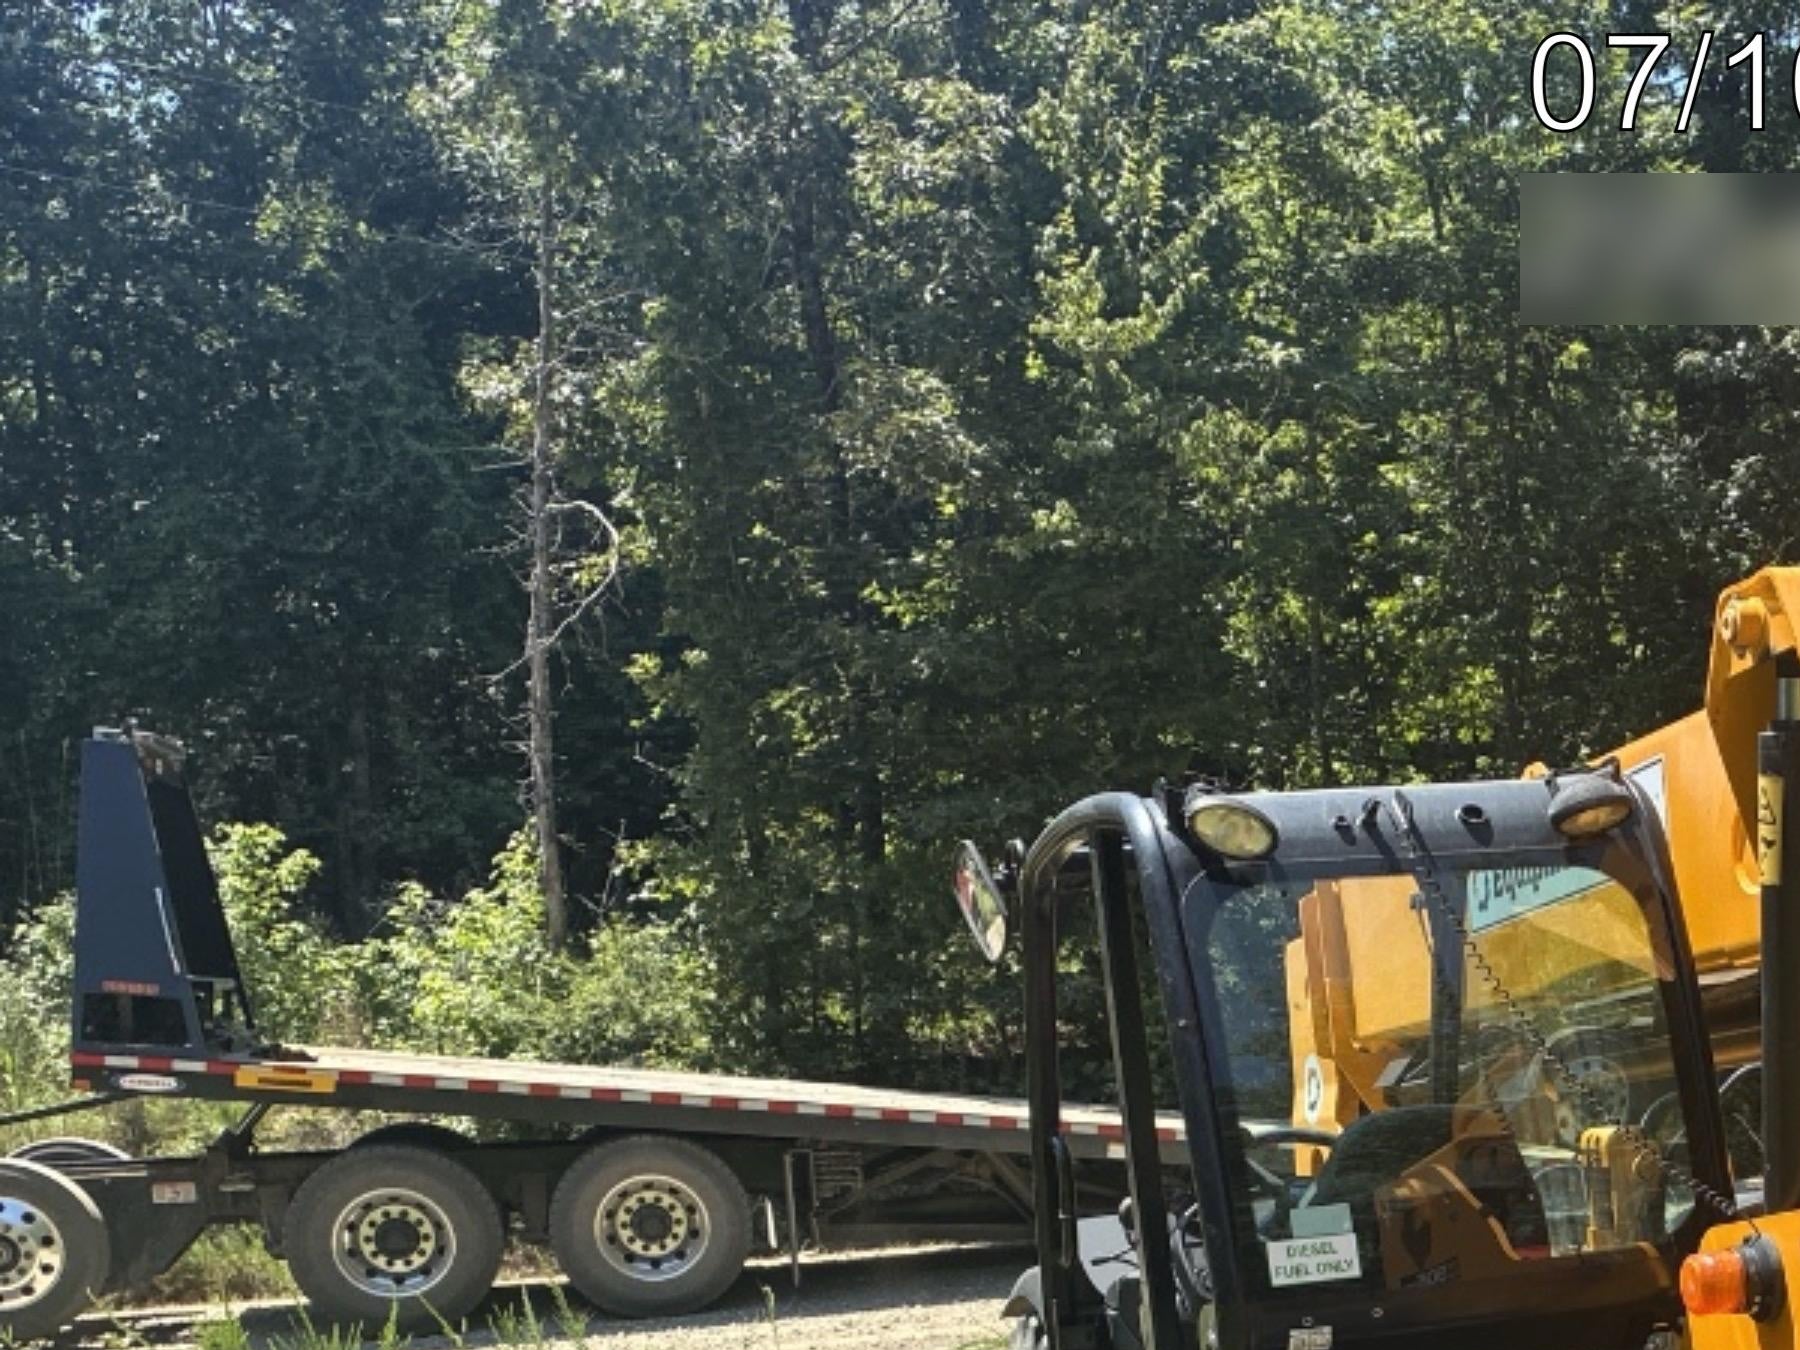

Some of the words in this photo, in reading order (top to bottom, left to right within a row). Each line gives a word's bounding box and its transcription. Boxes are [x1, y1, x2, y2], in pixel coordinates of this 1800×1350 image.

[1286, 1242, 1338, 1259] DIESEL
[1275, 1263, 1312, 1280] FUEL
[1315, 1257, 1354, 1274] ONLY
